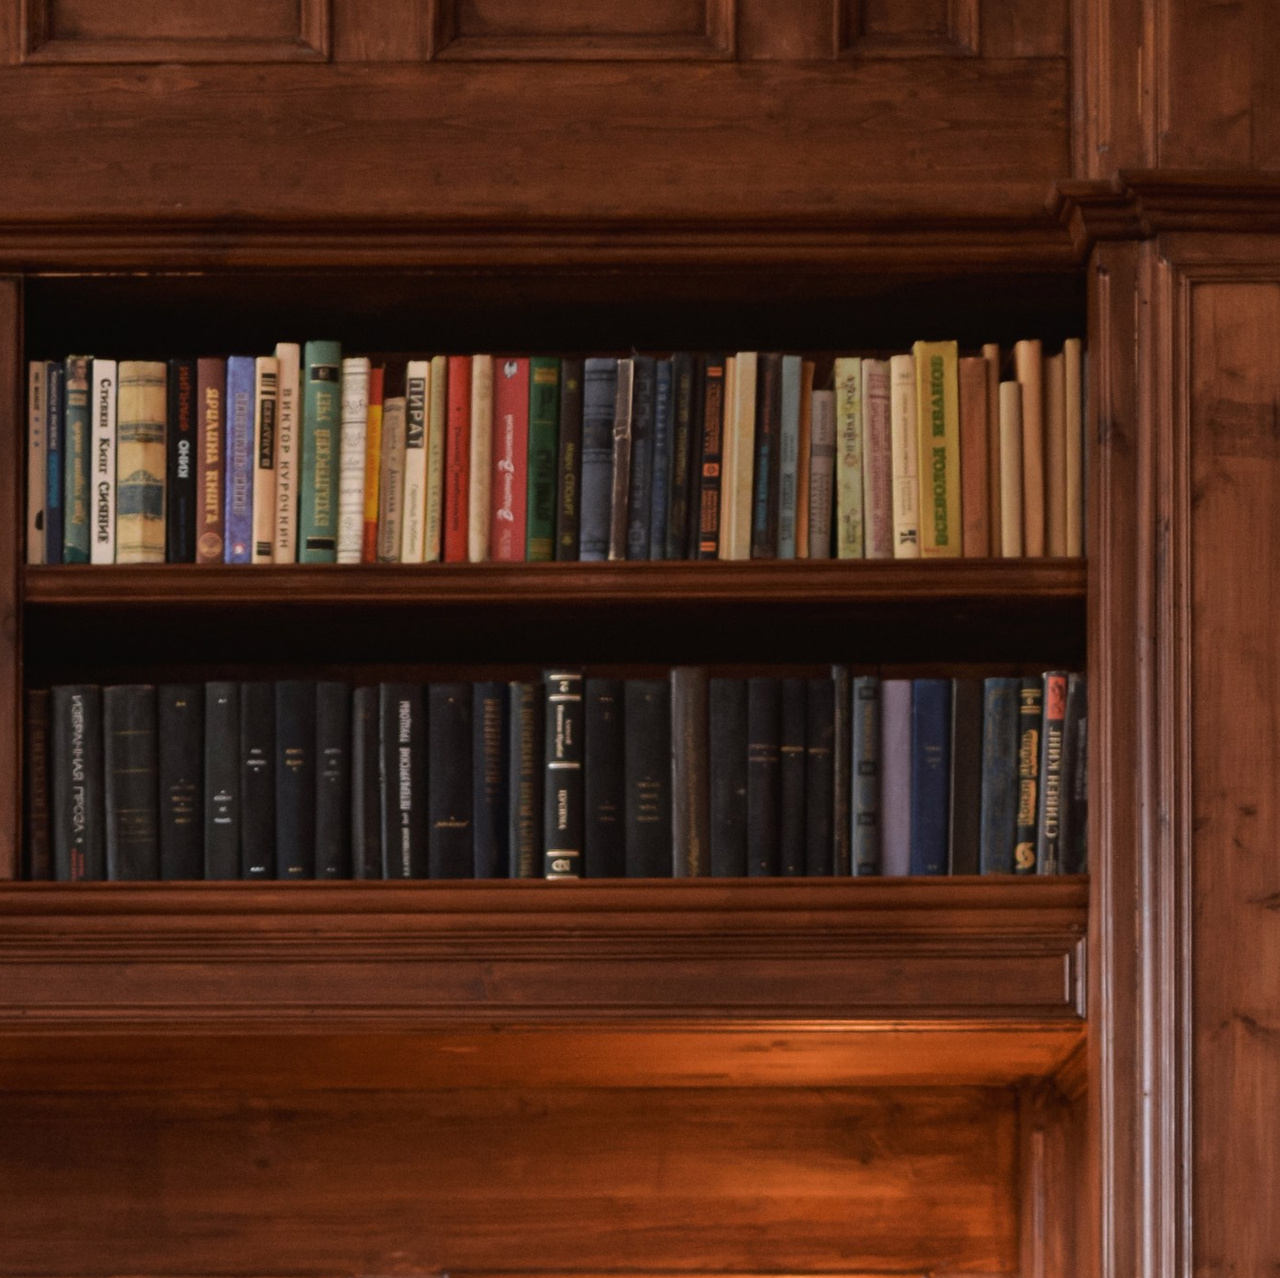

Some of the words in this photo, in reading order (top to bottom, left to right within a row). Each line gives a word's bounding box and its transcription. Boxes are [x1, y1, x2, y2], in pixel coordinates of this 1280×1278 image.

[178, 366, 191, 431] ФРАНЦИИ
[205, 387, 220, 463] ЯРИЛИНА
[281, 388, 293, 453] ВИКТОР
[407, 379, 424, 447] ПИРАТ
[930, 356, 945, 437] ИВАНОВ
[177, 440, 190, 478] КИНО
[313, 428, 332, 527] БУХГАЛТЕРСКИЙ
[97, 482, 110, 543] СИЯНИЕ
[205, 470, 219, 524] КНИГА
[279, 461, 290, 548] КУРОЧКИН
[932, 447, 948, 546] ВСЕВОЛОД
[72, 695, 83, 780] ИЗБРАННАЯ
[399, 700, 413, 742] ТРУЩОБЫ
[1048, 726, 1061, 770] КИНГ
[72, 786, 84, 832] ПРОЗА
[398, 747, 411, 810] ПЕТЕРБУРГСКИЕ
[558, 789, 567, 830] ЦУСИМА
[1045, 775, 1060, 838] СТИВЕН
